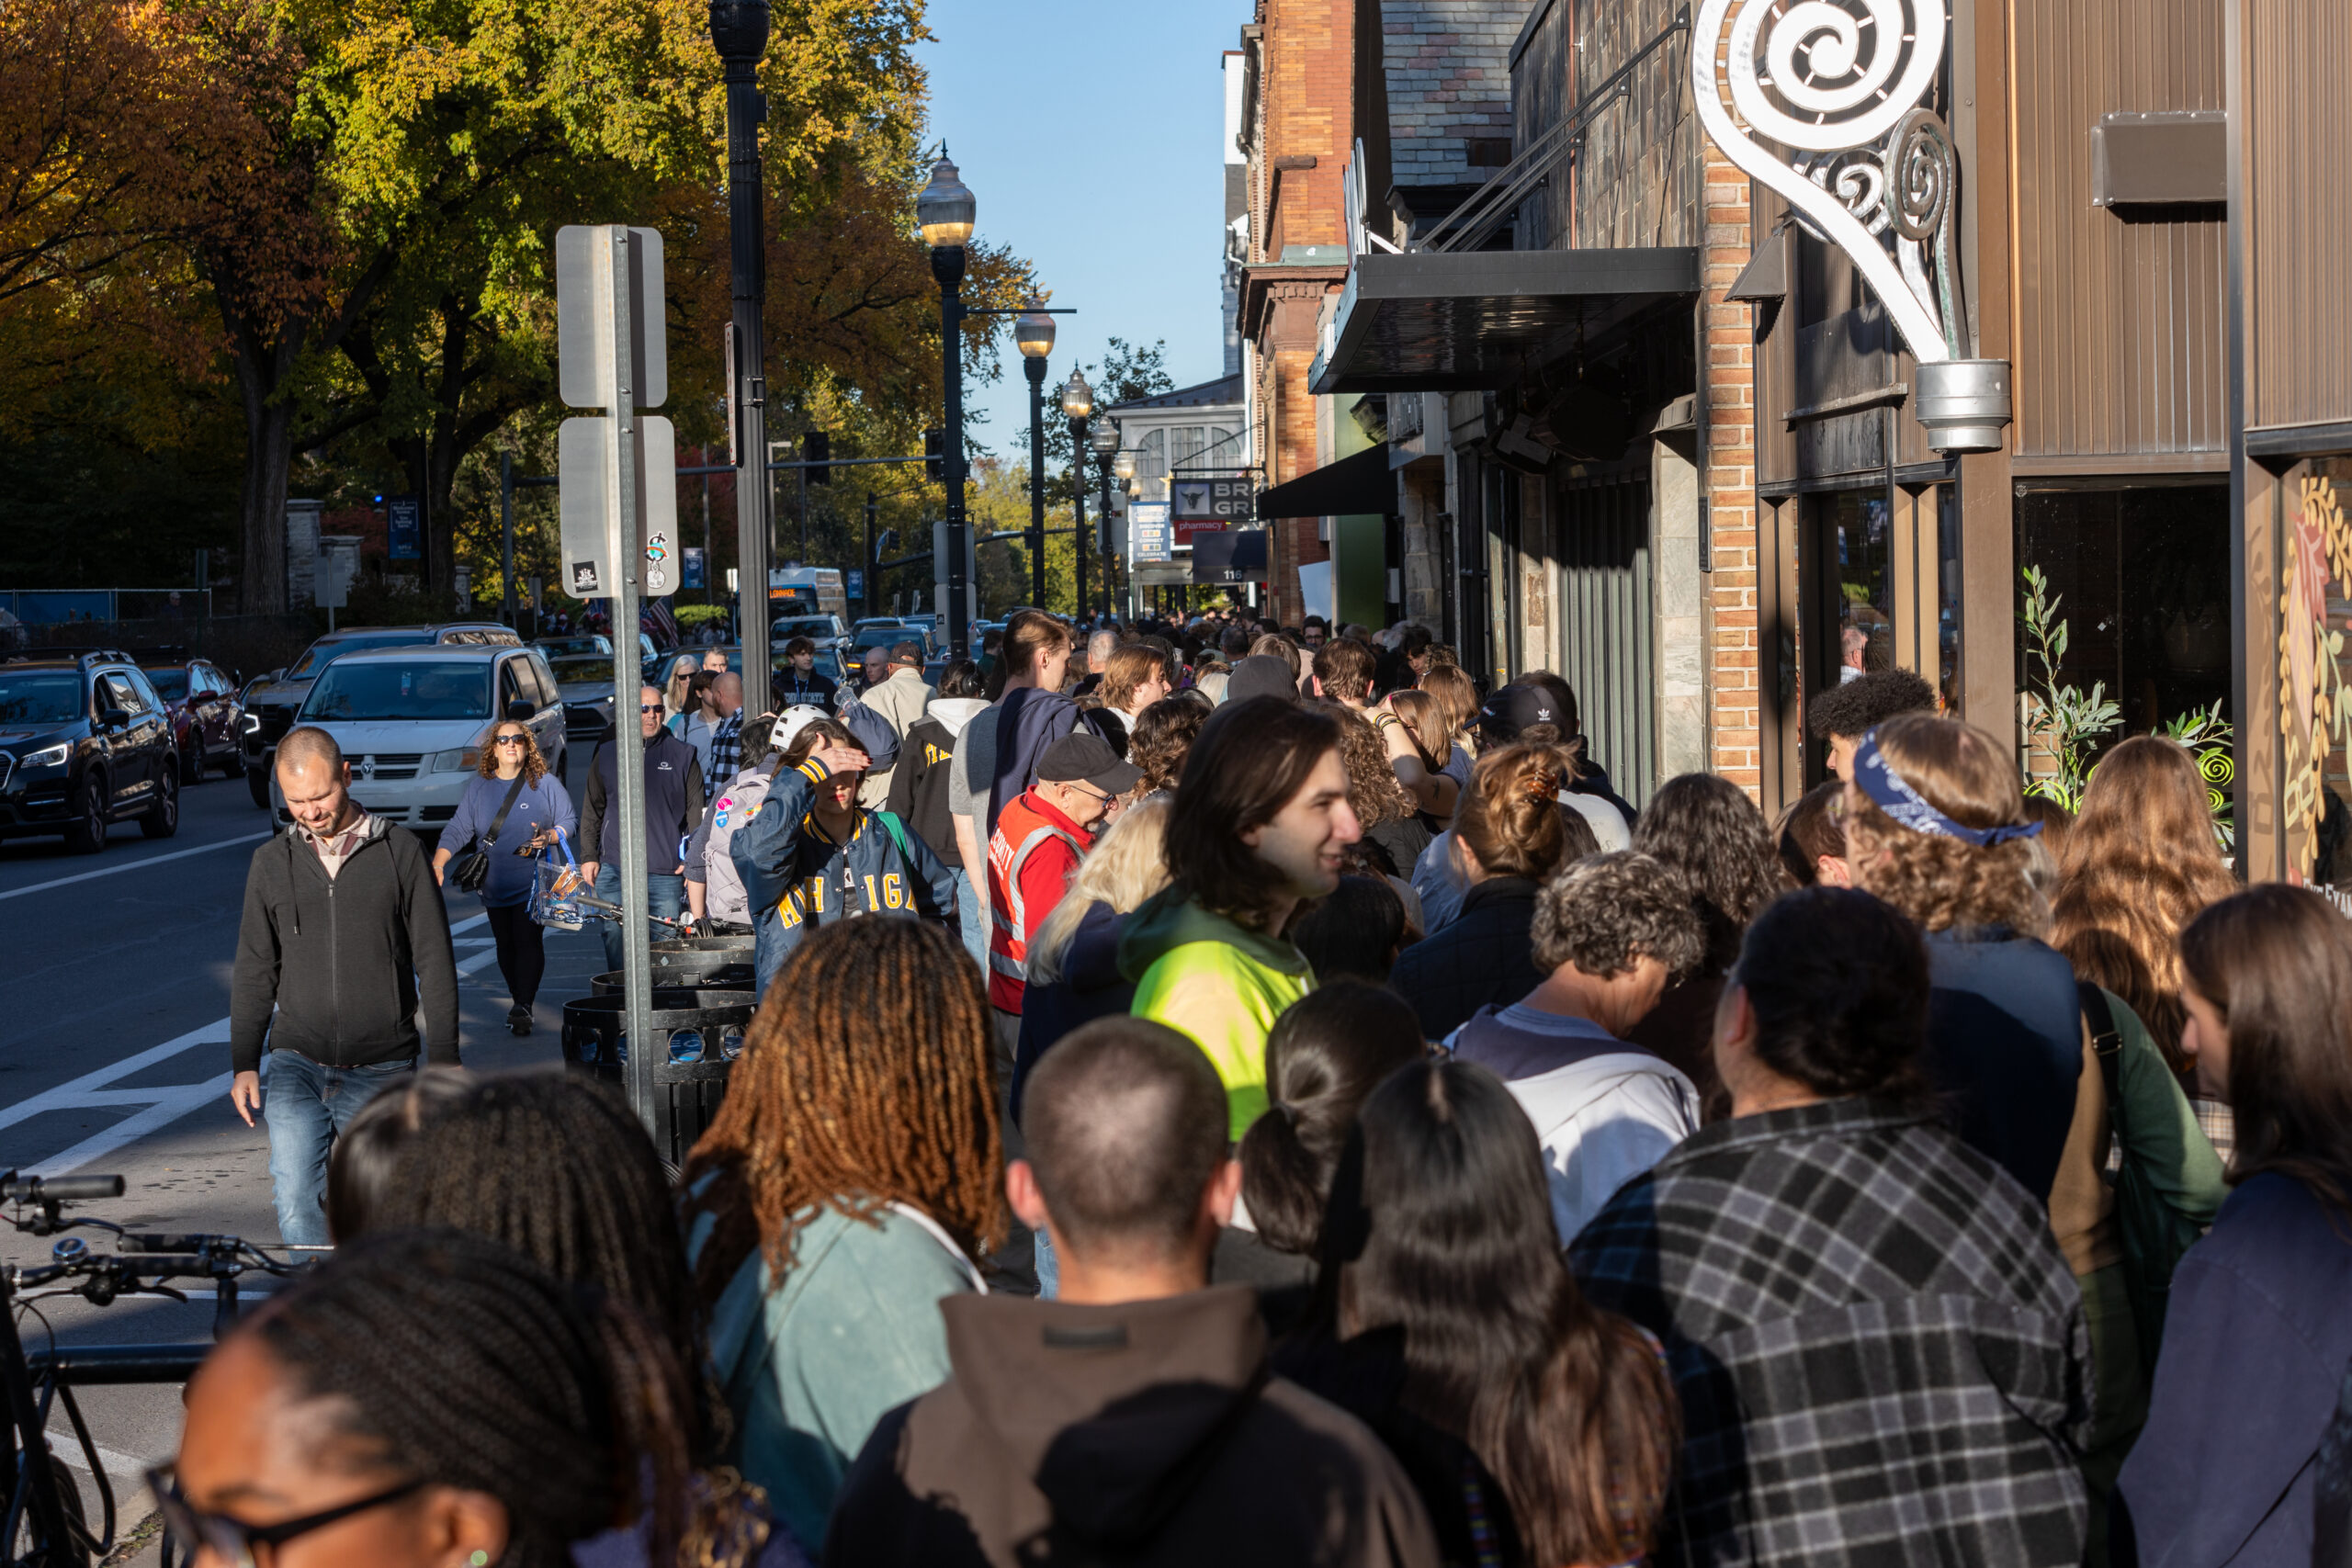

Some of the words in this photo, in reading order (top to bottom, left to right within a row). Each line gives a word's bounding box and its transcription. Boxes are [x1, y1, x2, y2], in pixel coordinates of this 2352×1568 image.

[1214, 482, 1250, 497] BR
[1214, 501, 1250, 514] GR
[1179, 521, 1223, 532] pharmacy
[1224, 570, 1242, 581] 116
